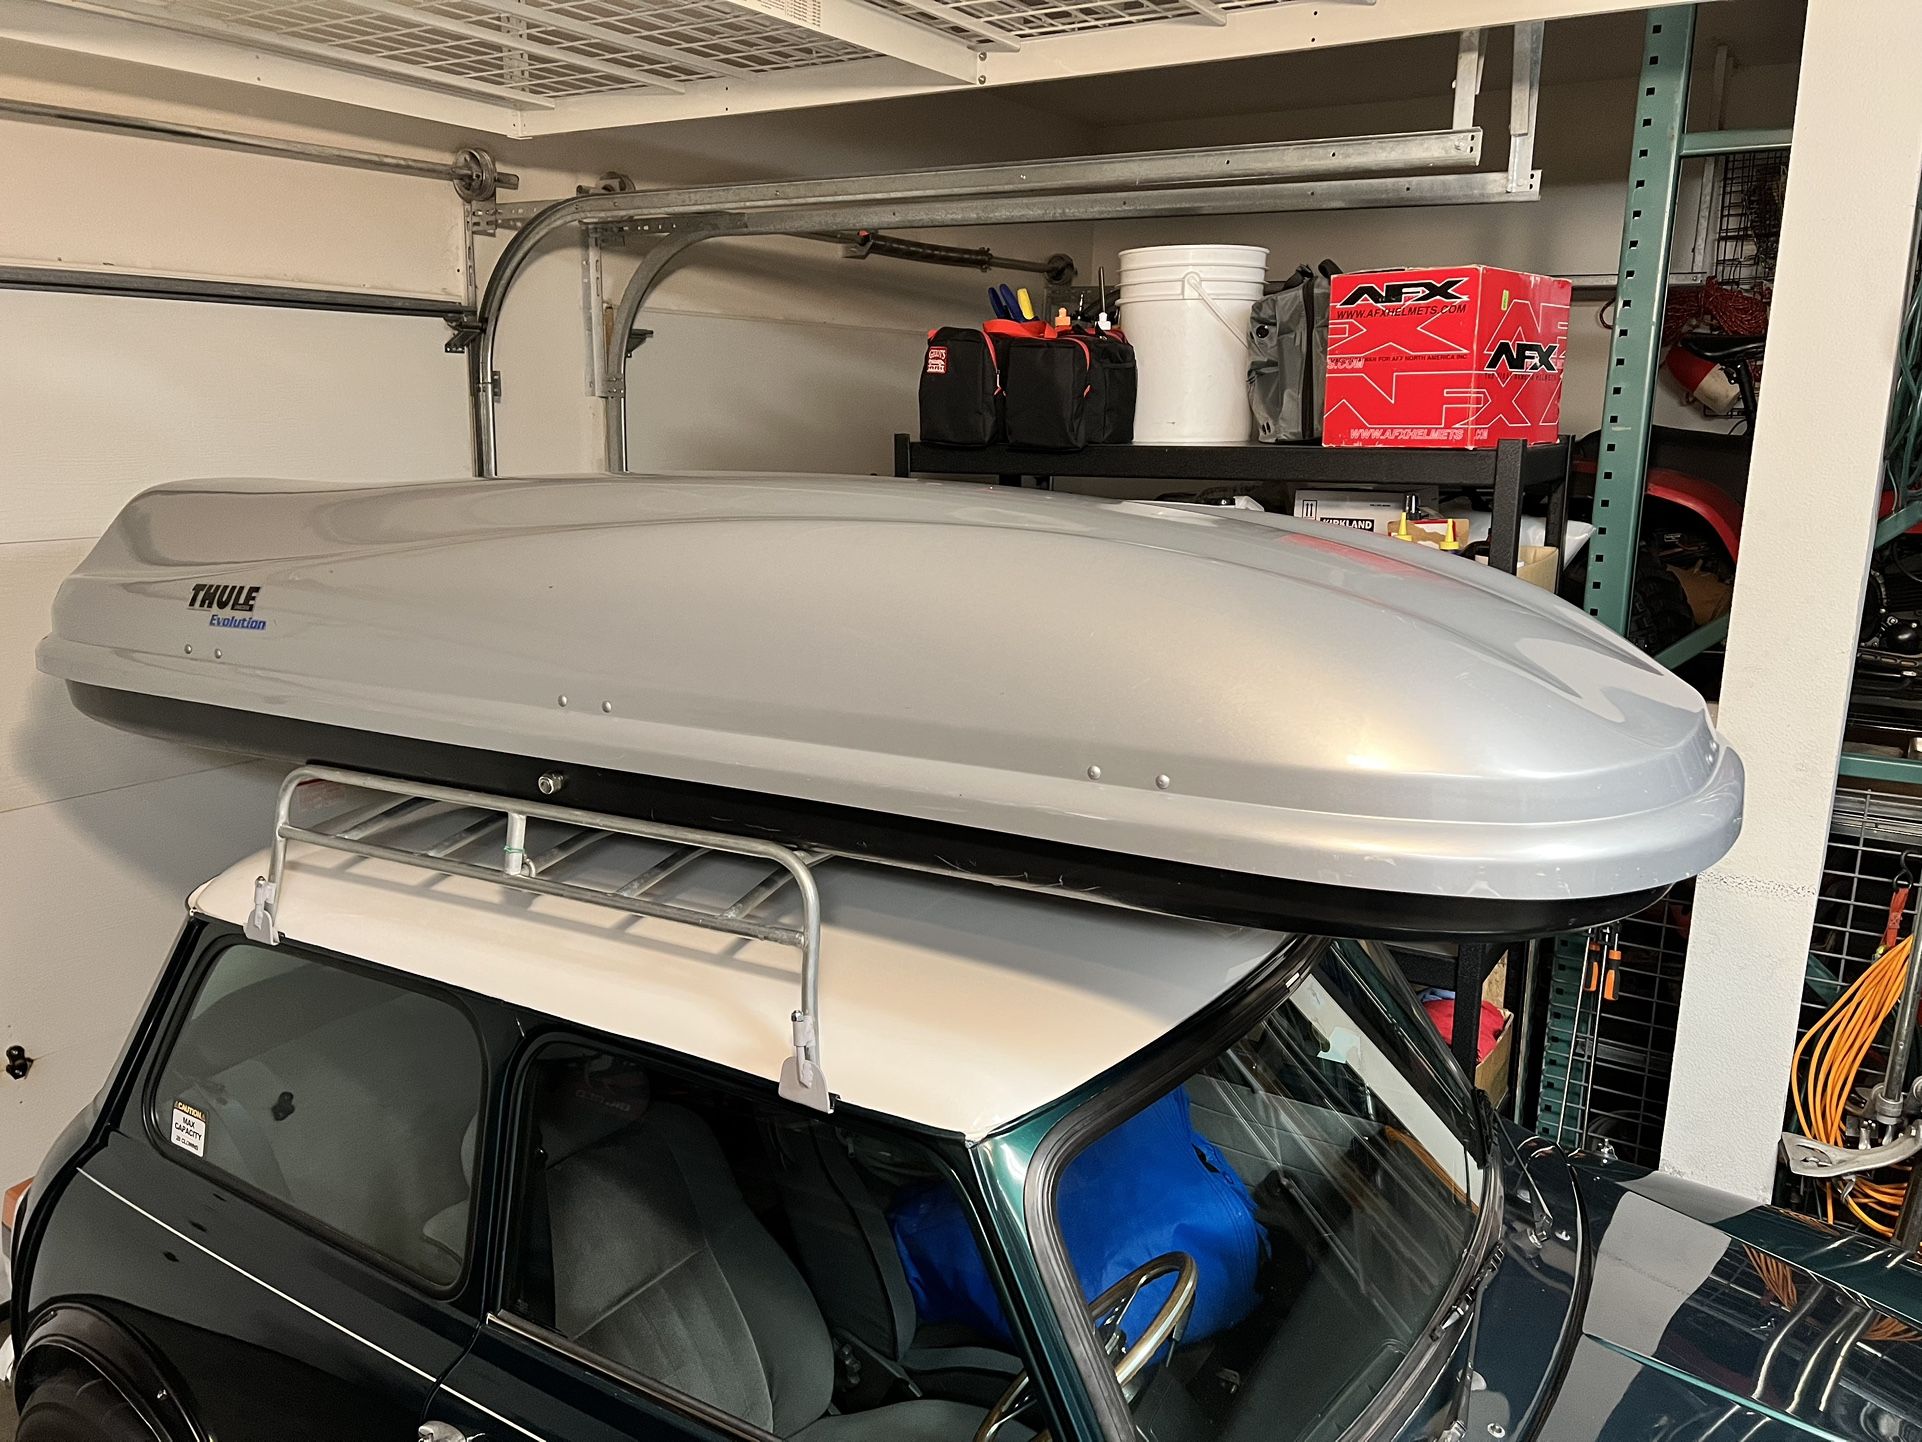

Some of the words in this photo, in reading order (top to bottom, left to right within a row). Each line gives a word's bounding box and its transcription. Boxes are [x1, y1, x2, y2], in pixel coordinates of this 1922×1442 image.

[1336, 277, 1470, 308] AFX
[1337, 304, 1466, 319] WWW.AFXHELMETS.COM
[1484, 340, 1558, 372] AFX
[187, 583, 262, 612] THULE
[209, 614, 266, 630] Evolution
[178, 1101, 202, 1119] CAUTION
[174, 1122, 202, 1140] CAPACITY
[182, 1116, 196, 1129] MAX
